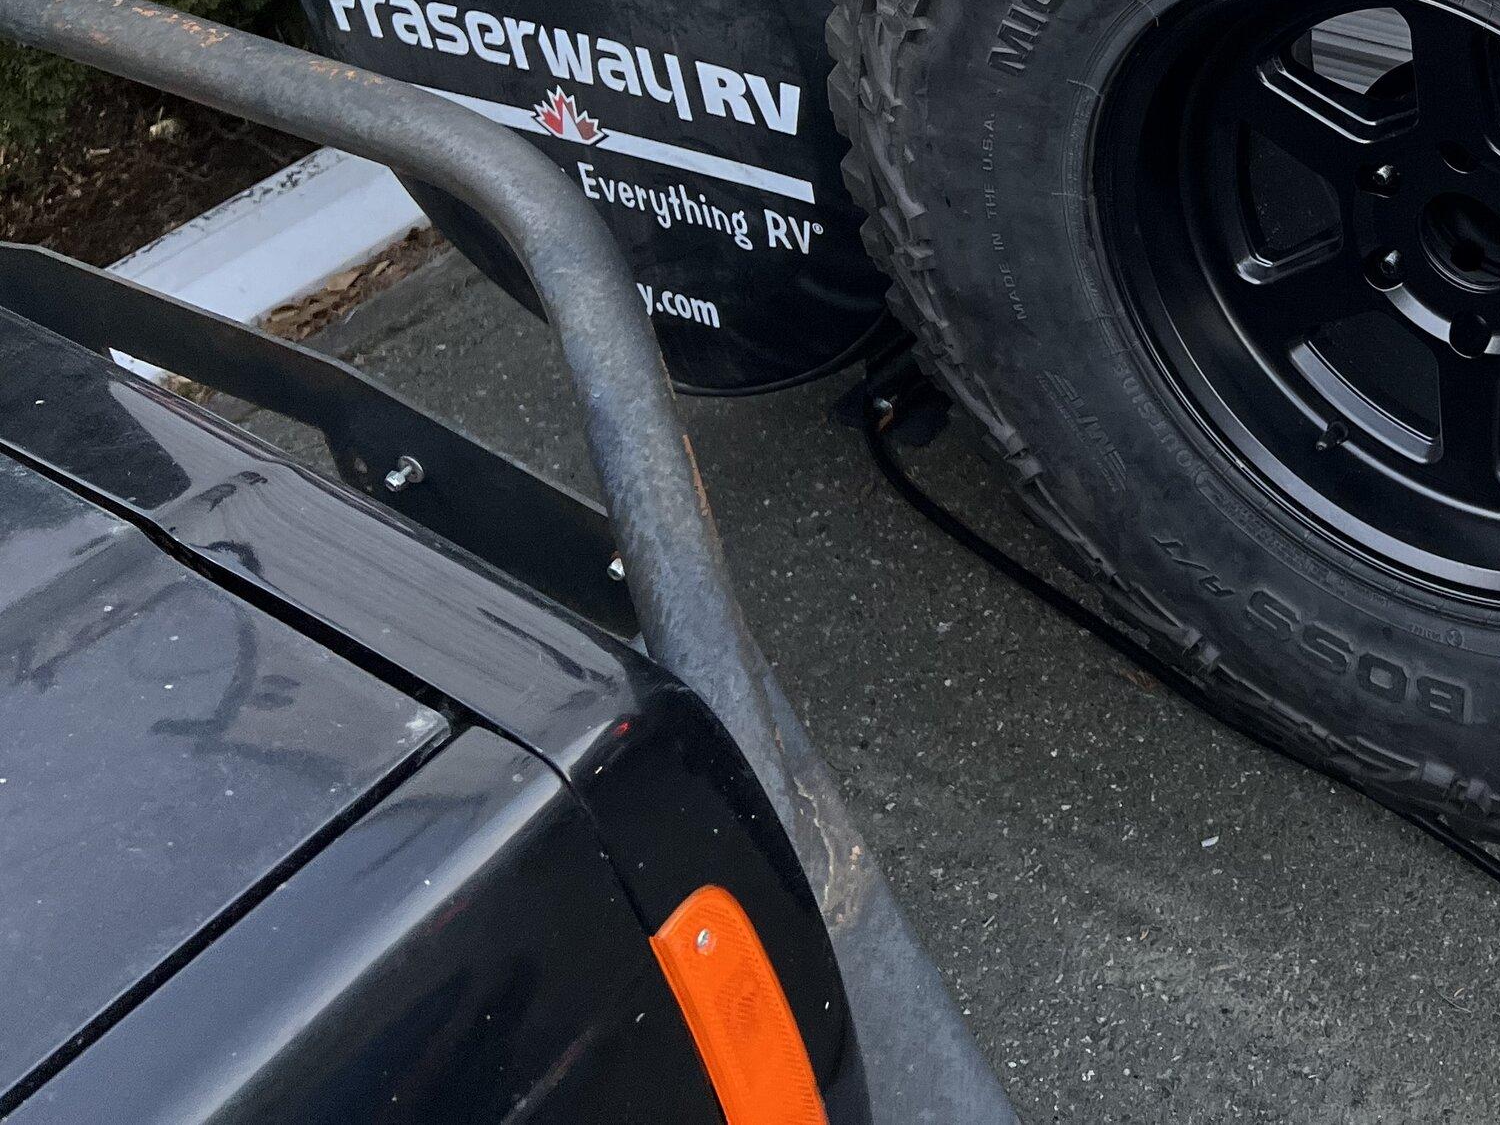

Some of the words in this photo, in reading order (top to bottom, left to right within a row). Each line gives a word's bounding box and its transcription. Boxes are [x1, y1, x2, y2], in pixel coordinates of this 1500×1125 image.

[694, 60, 801, 136] RV
[982, 112, 996, 171] U.S.A.
[576, 160, 754, 251] Everything
[983, 182, 999, 220] THE
[991, 232, 1006, 252] IN
[1000, 260, 1028, 321] MADE
[1149, 535, 1236, 598] A/T
[1248, 586, 1470, 724] BOSS
